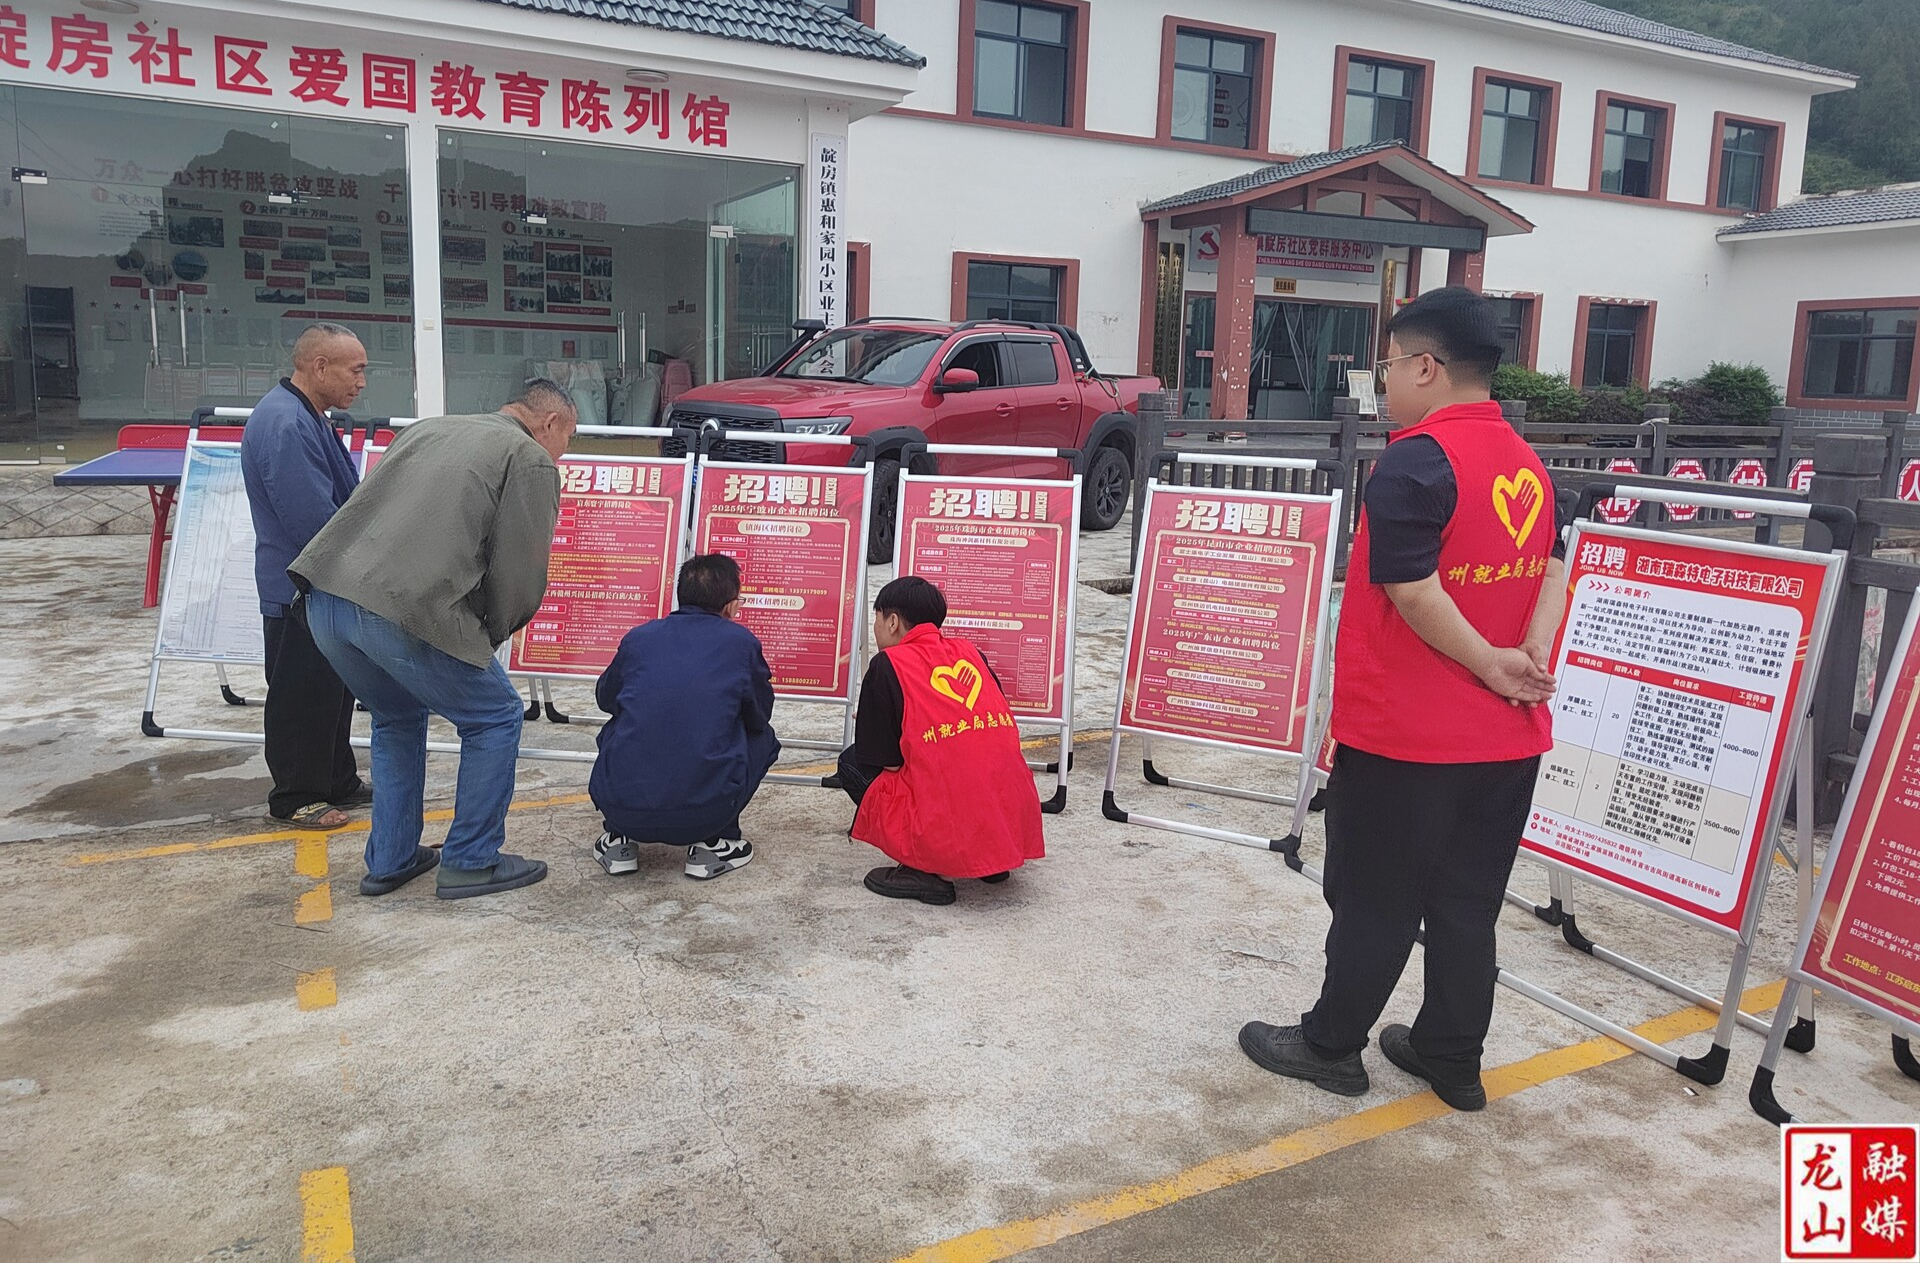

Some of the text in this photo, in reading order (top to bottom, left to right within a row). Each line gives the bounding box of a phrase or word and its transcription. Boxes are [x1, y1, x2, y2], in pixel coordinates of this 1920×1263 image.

[819, 147, 837, 374] 靛房镇惠和家园小区业主会
[1579, 541, 1627, 570] 招聘
[1579, 564, 1625, 577] JOIN US NOW
[1636, 556, 1804, 599] 湖南瑞森特电子科技有限公司
[1614, 585, 1652, 600] 公司简介
[1611, 712, 1620, 720] 20
[1594, 783, 1600, 791] 2
[1703, 819, 1740, 836] 3500-8000
